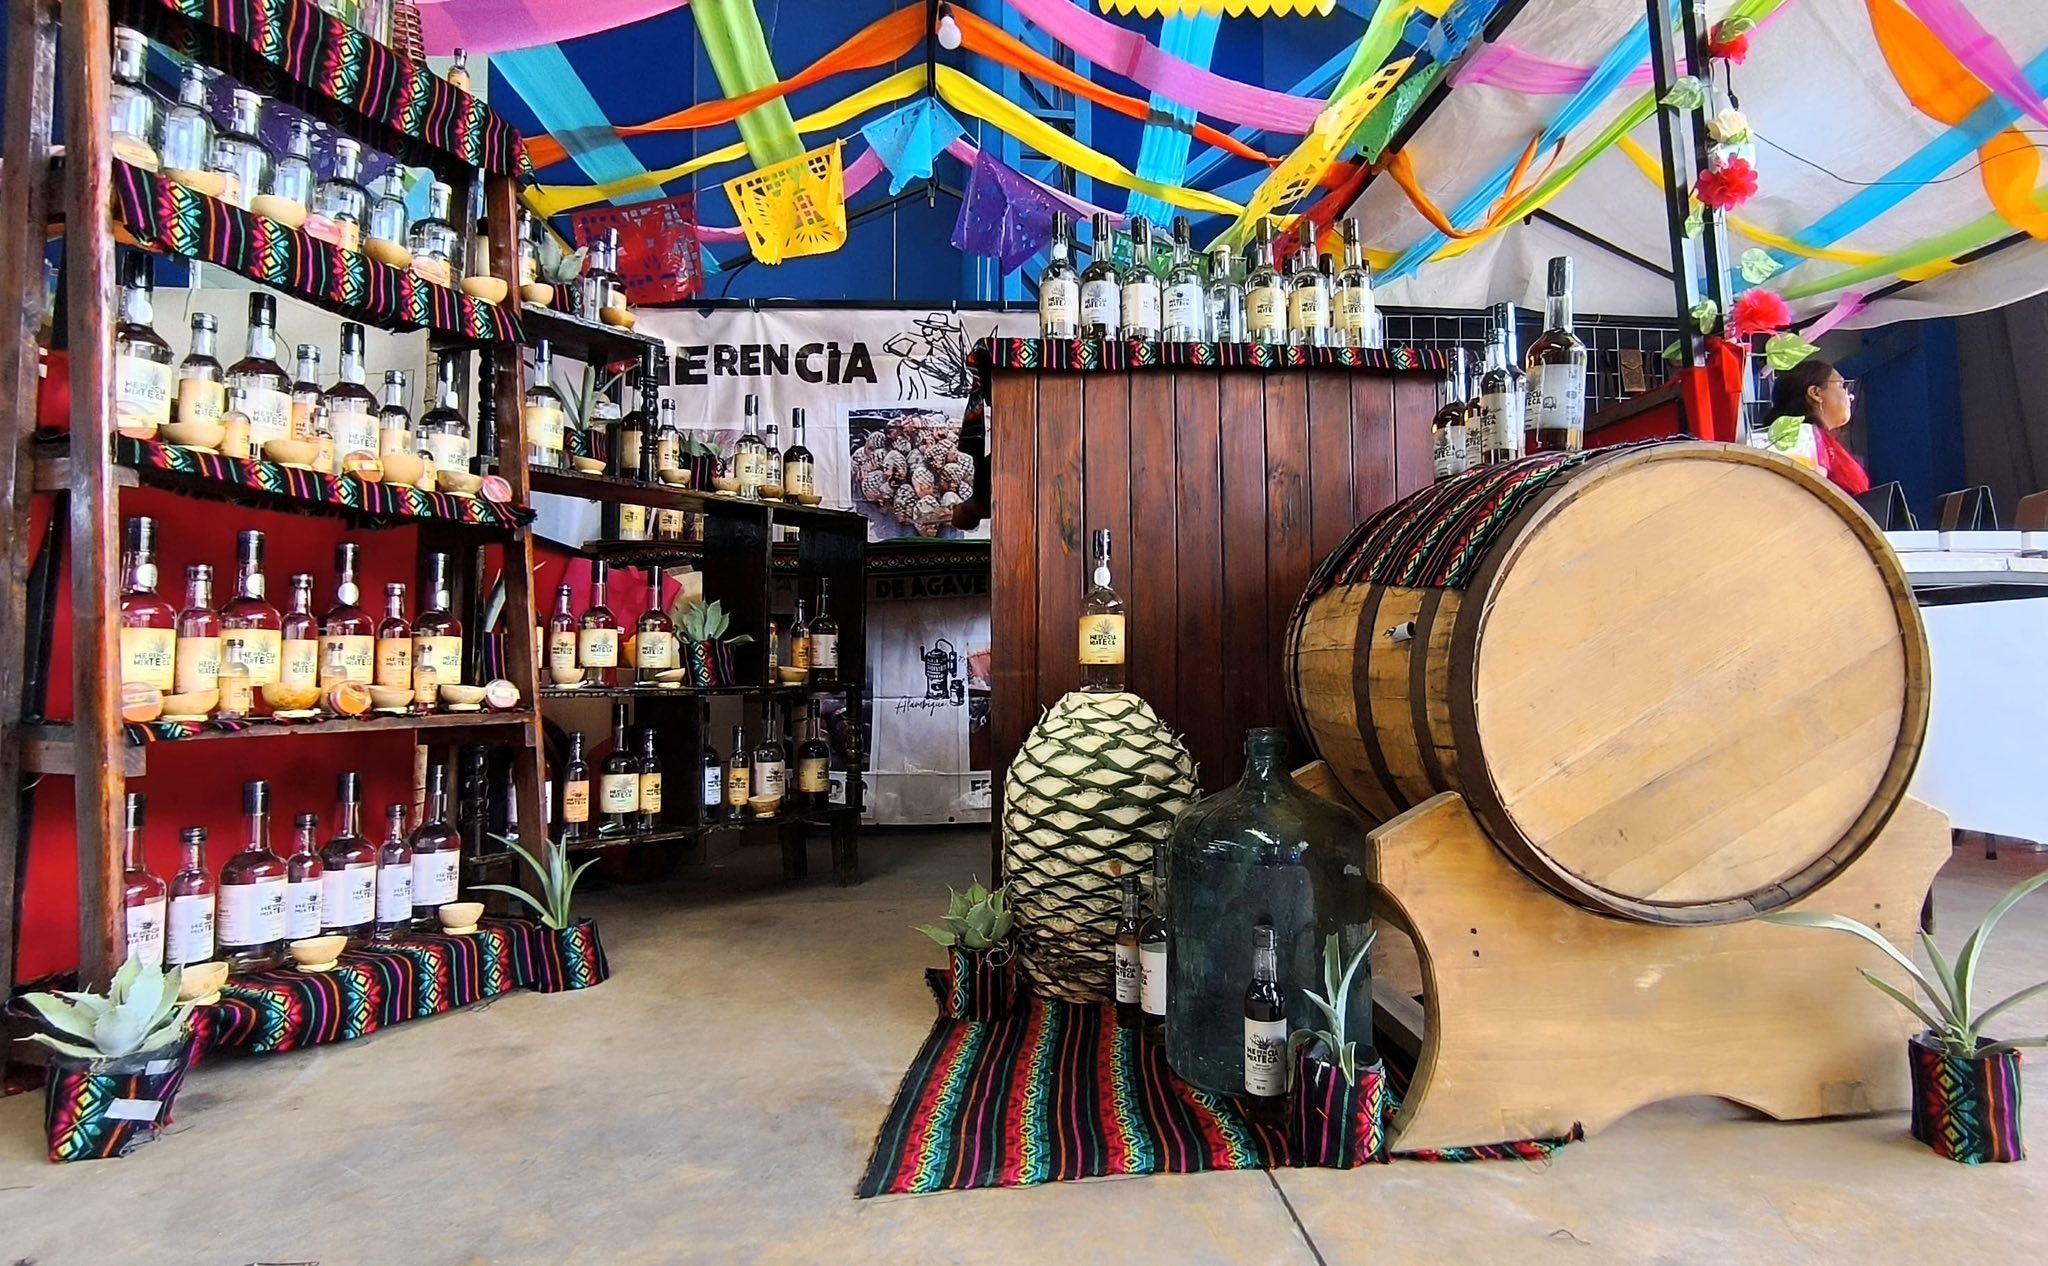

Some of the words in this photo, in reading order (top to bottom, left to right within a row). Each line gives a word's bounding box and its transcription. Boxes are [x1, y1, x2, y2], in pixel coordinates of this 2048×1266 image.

[875, 579, 906, 599] DE
[911, 574, 988, 598] AGAVE
[133, 657, 170, 667] MIXTECA
[134, 652, 171, 661] HERENCIA
[1246, 1046, 1279, 1057] HERENCIA
[1246, 1053, 1279, 1064] MIXTECA
